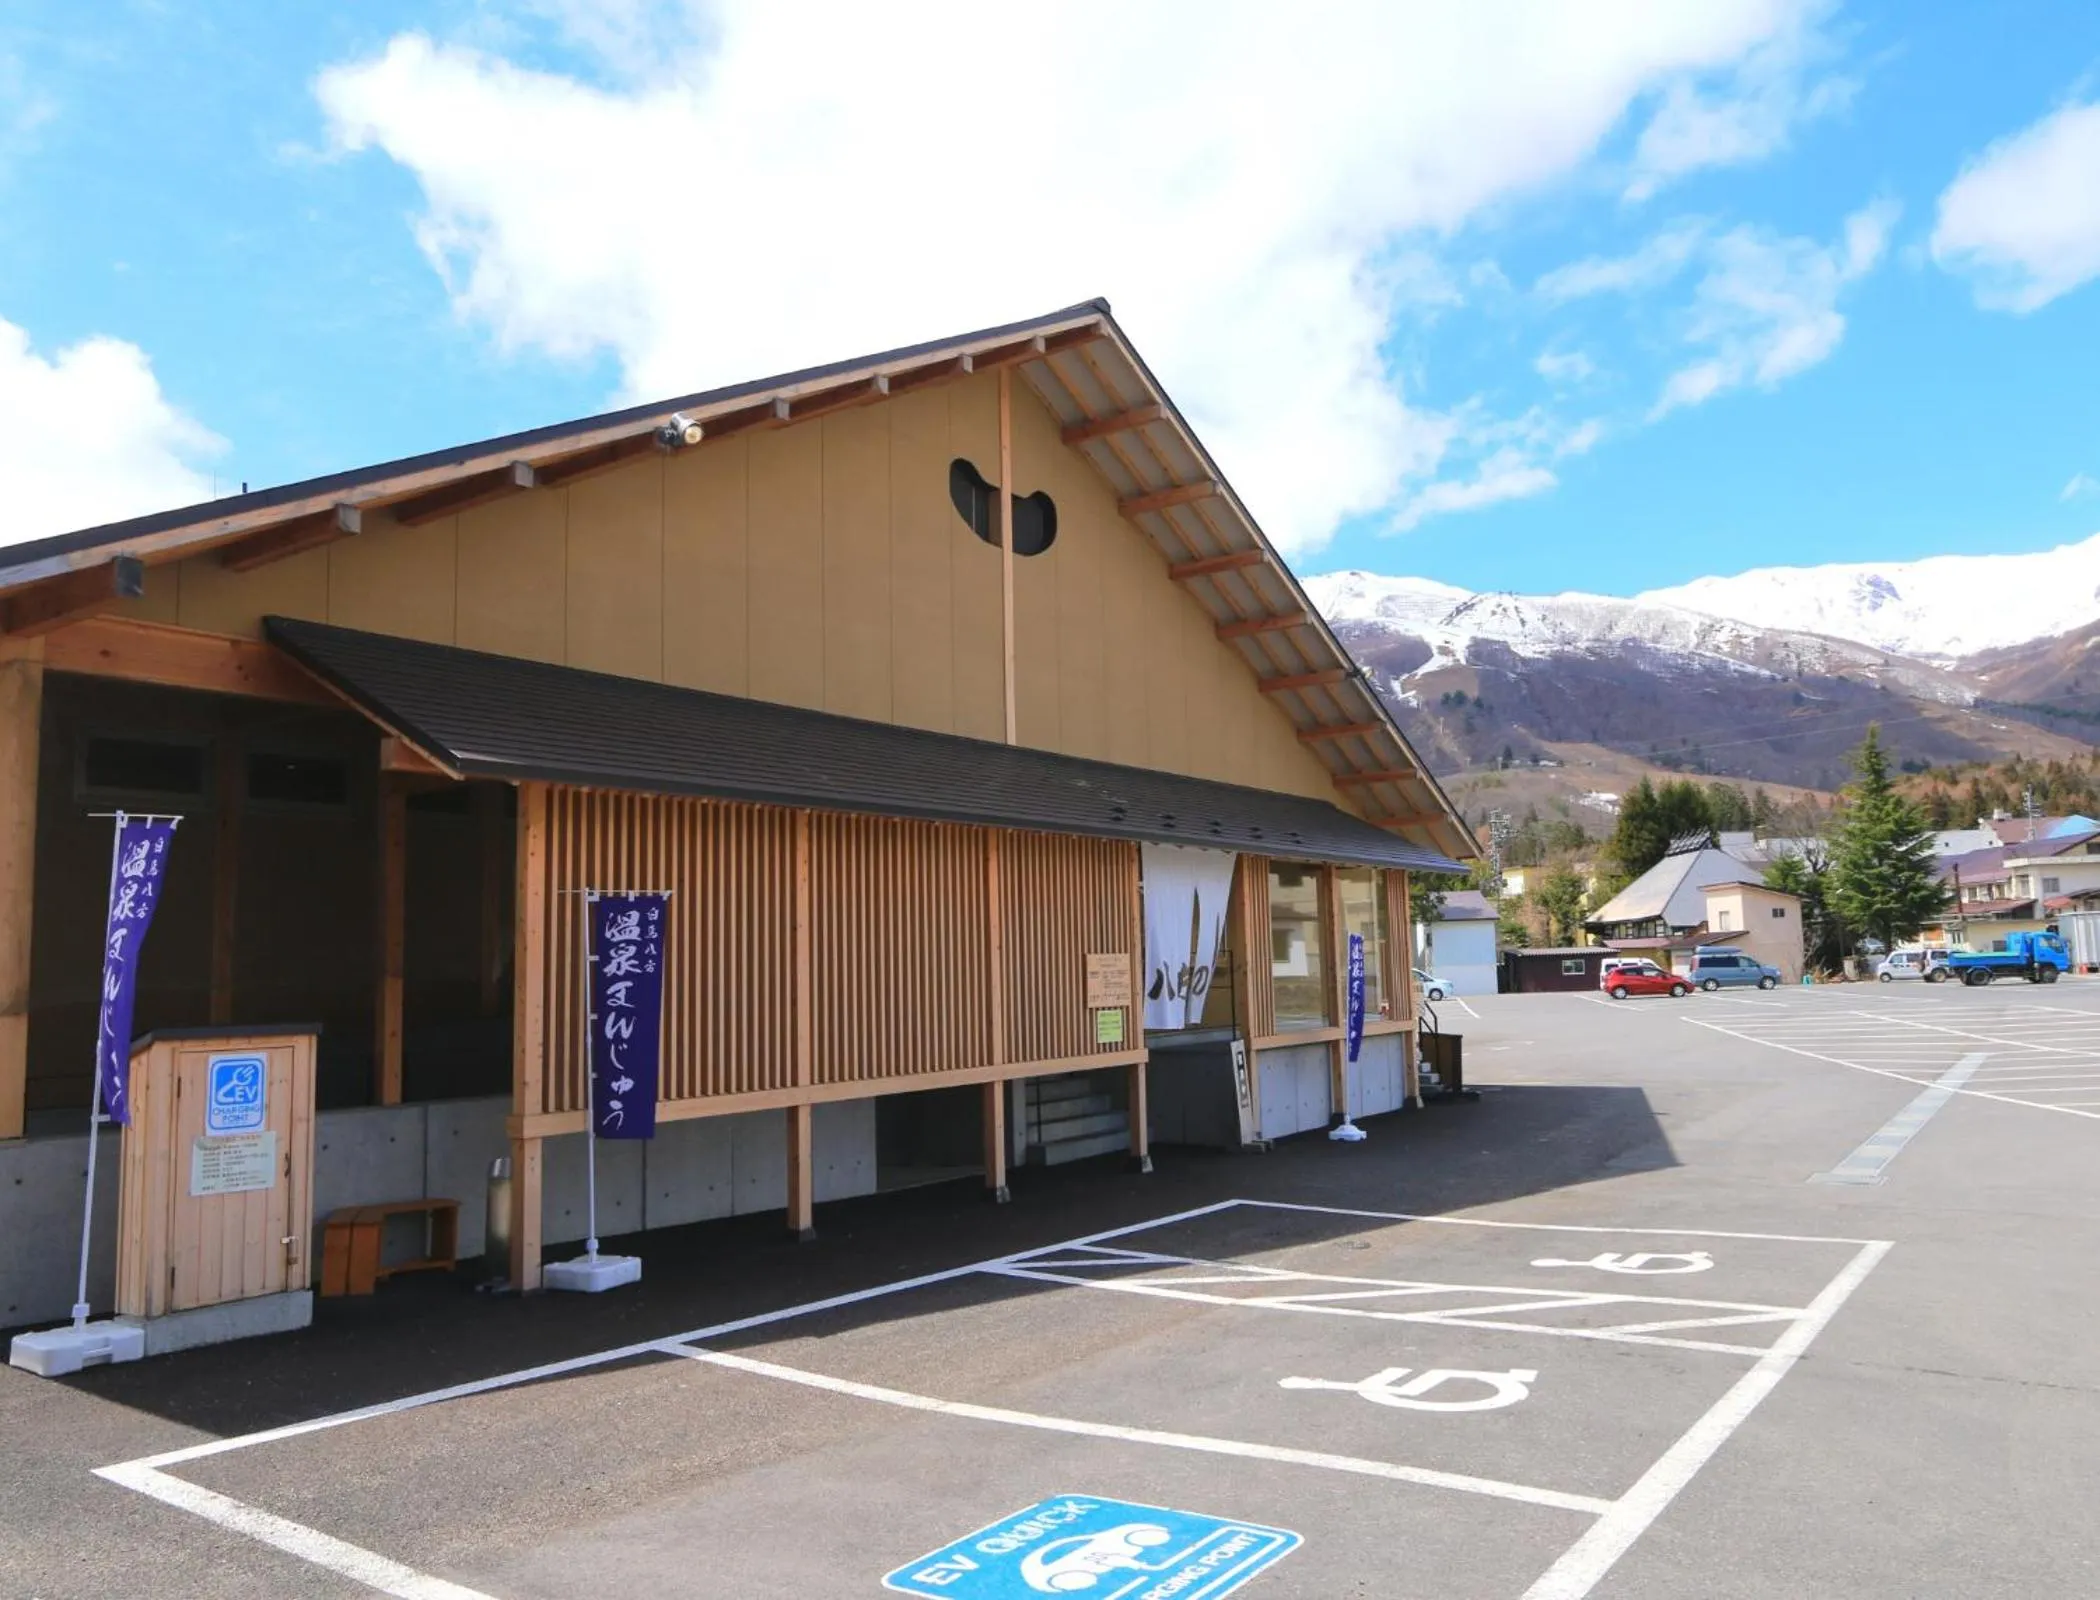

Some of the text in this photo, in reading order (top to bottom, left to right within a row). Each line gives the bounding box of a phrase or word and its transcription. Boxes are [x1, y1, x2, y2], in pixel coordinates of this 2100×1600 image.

[103, 839, 150, 1107] 温泉まんじう
[644, 907, 660, 973] 白馬八方
[602, 910, 643, 1131] 温泉まんじゅう
[235, 1084, 257, 1102] EV
[911, 1500, 1100, 1586] EV QUICK
[1198, 1533, 1259, 1567] POINT
